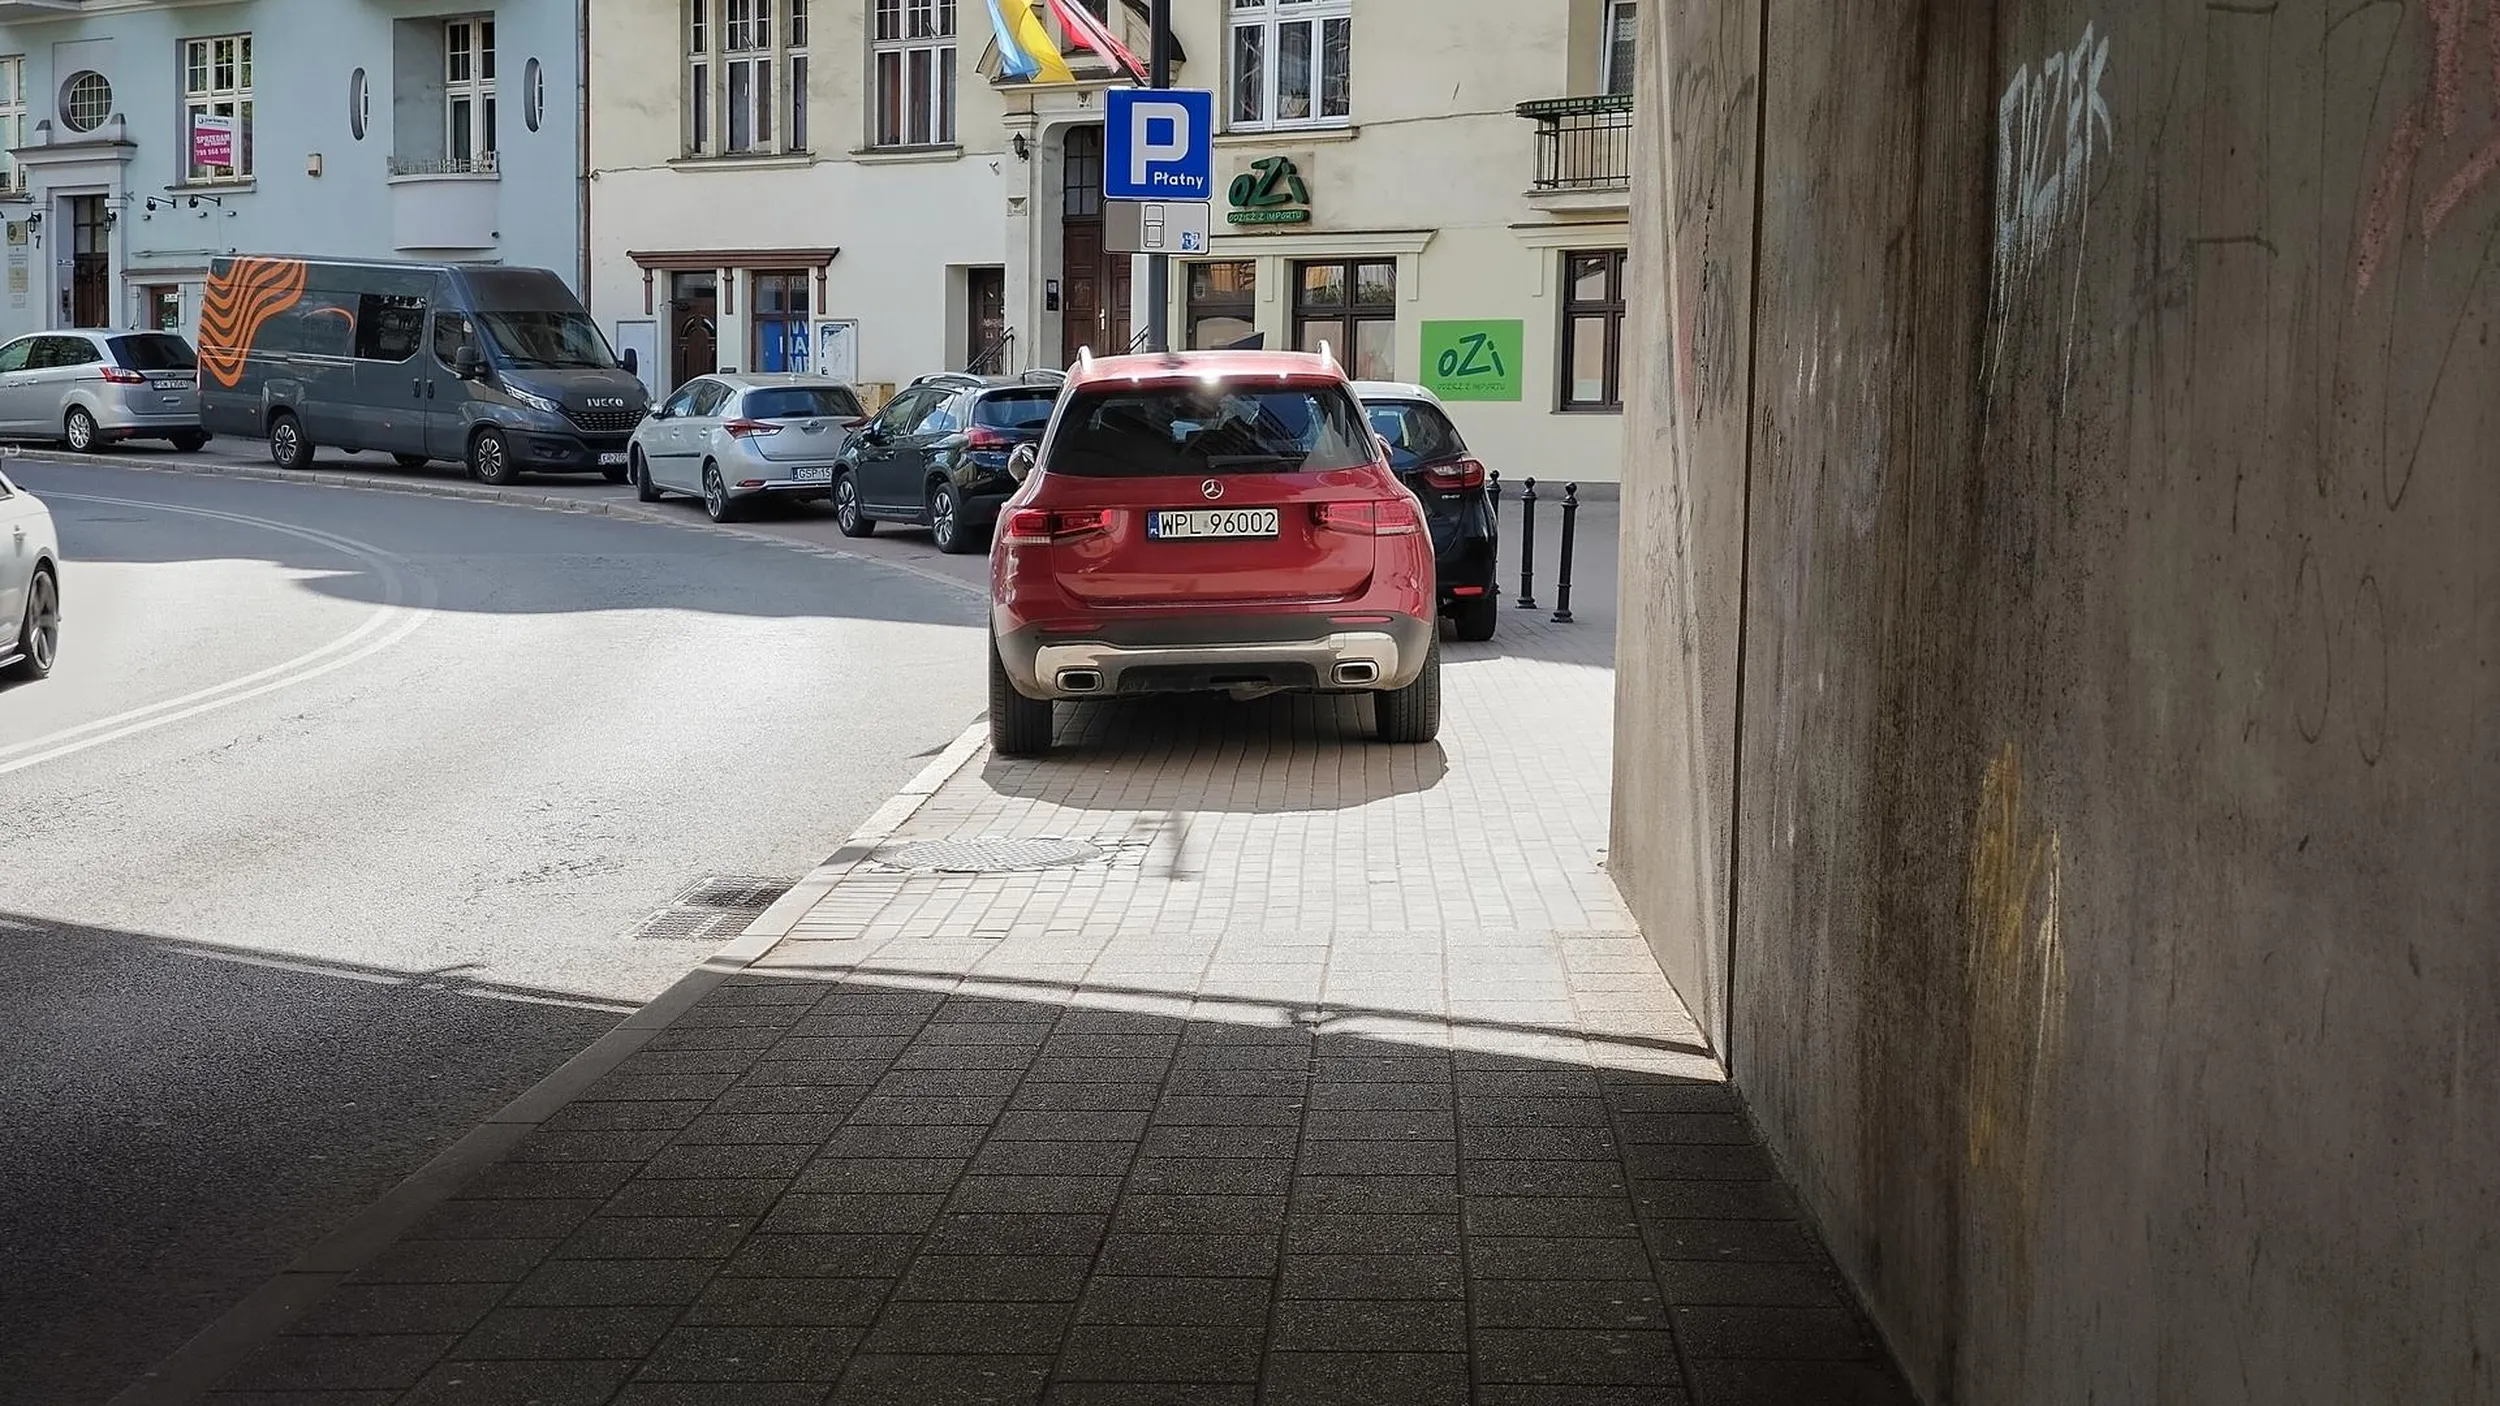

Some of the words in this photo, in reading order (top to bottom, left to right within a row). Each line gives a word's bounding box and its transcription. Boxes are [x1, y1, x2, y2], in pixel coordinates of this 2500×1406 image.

[1130, 102, 1190, 185] P
[1153, 171, 1204, 190] Płatny
[35, 235, 42, 249] 7
[587, 398, 624, 407] IVECO
[799, 469, 817, 479] GSP
[1161, 513, 1202, 535] WPL
[1210, 511, 1276, 533] 96002
